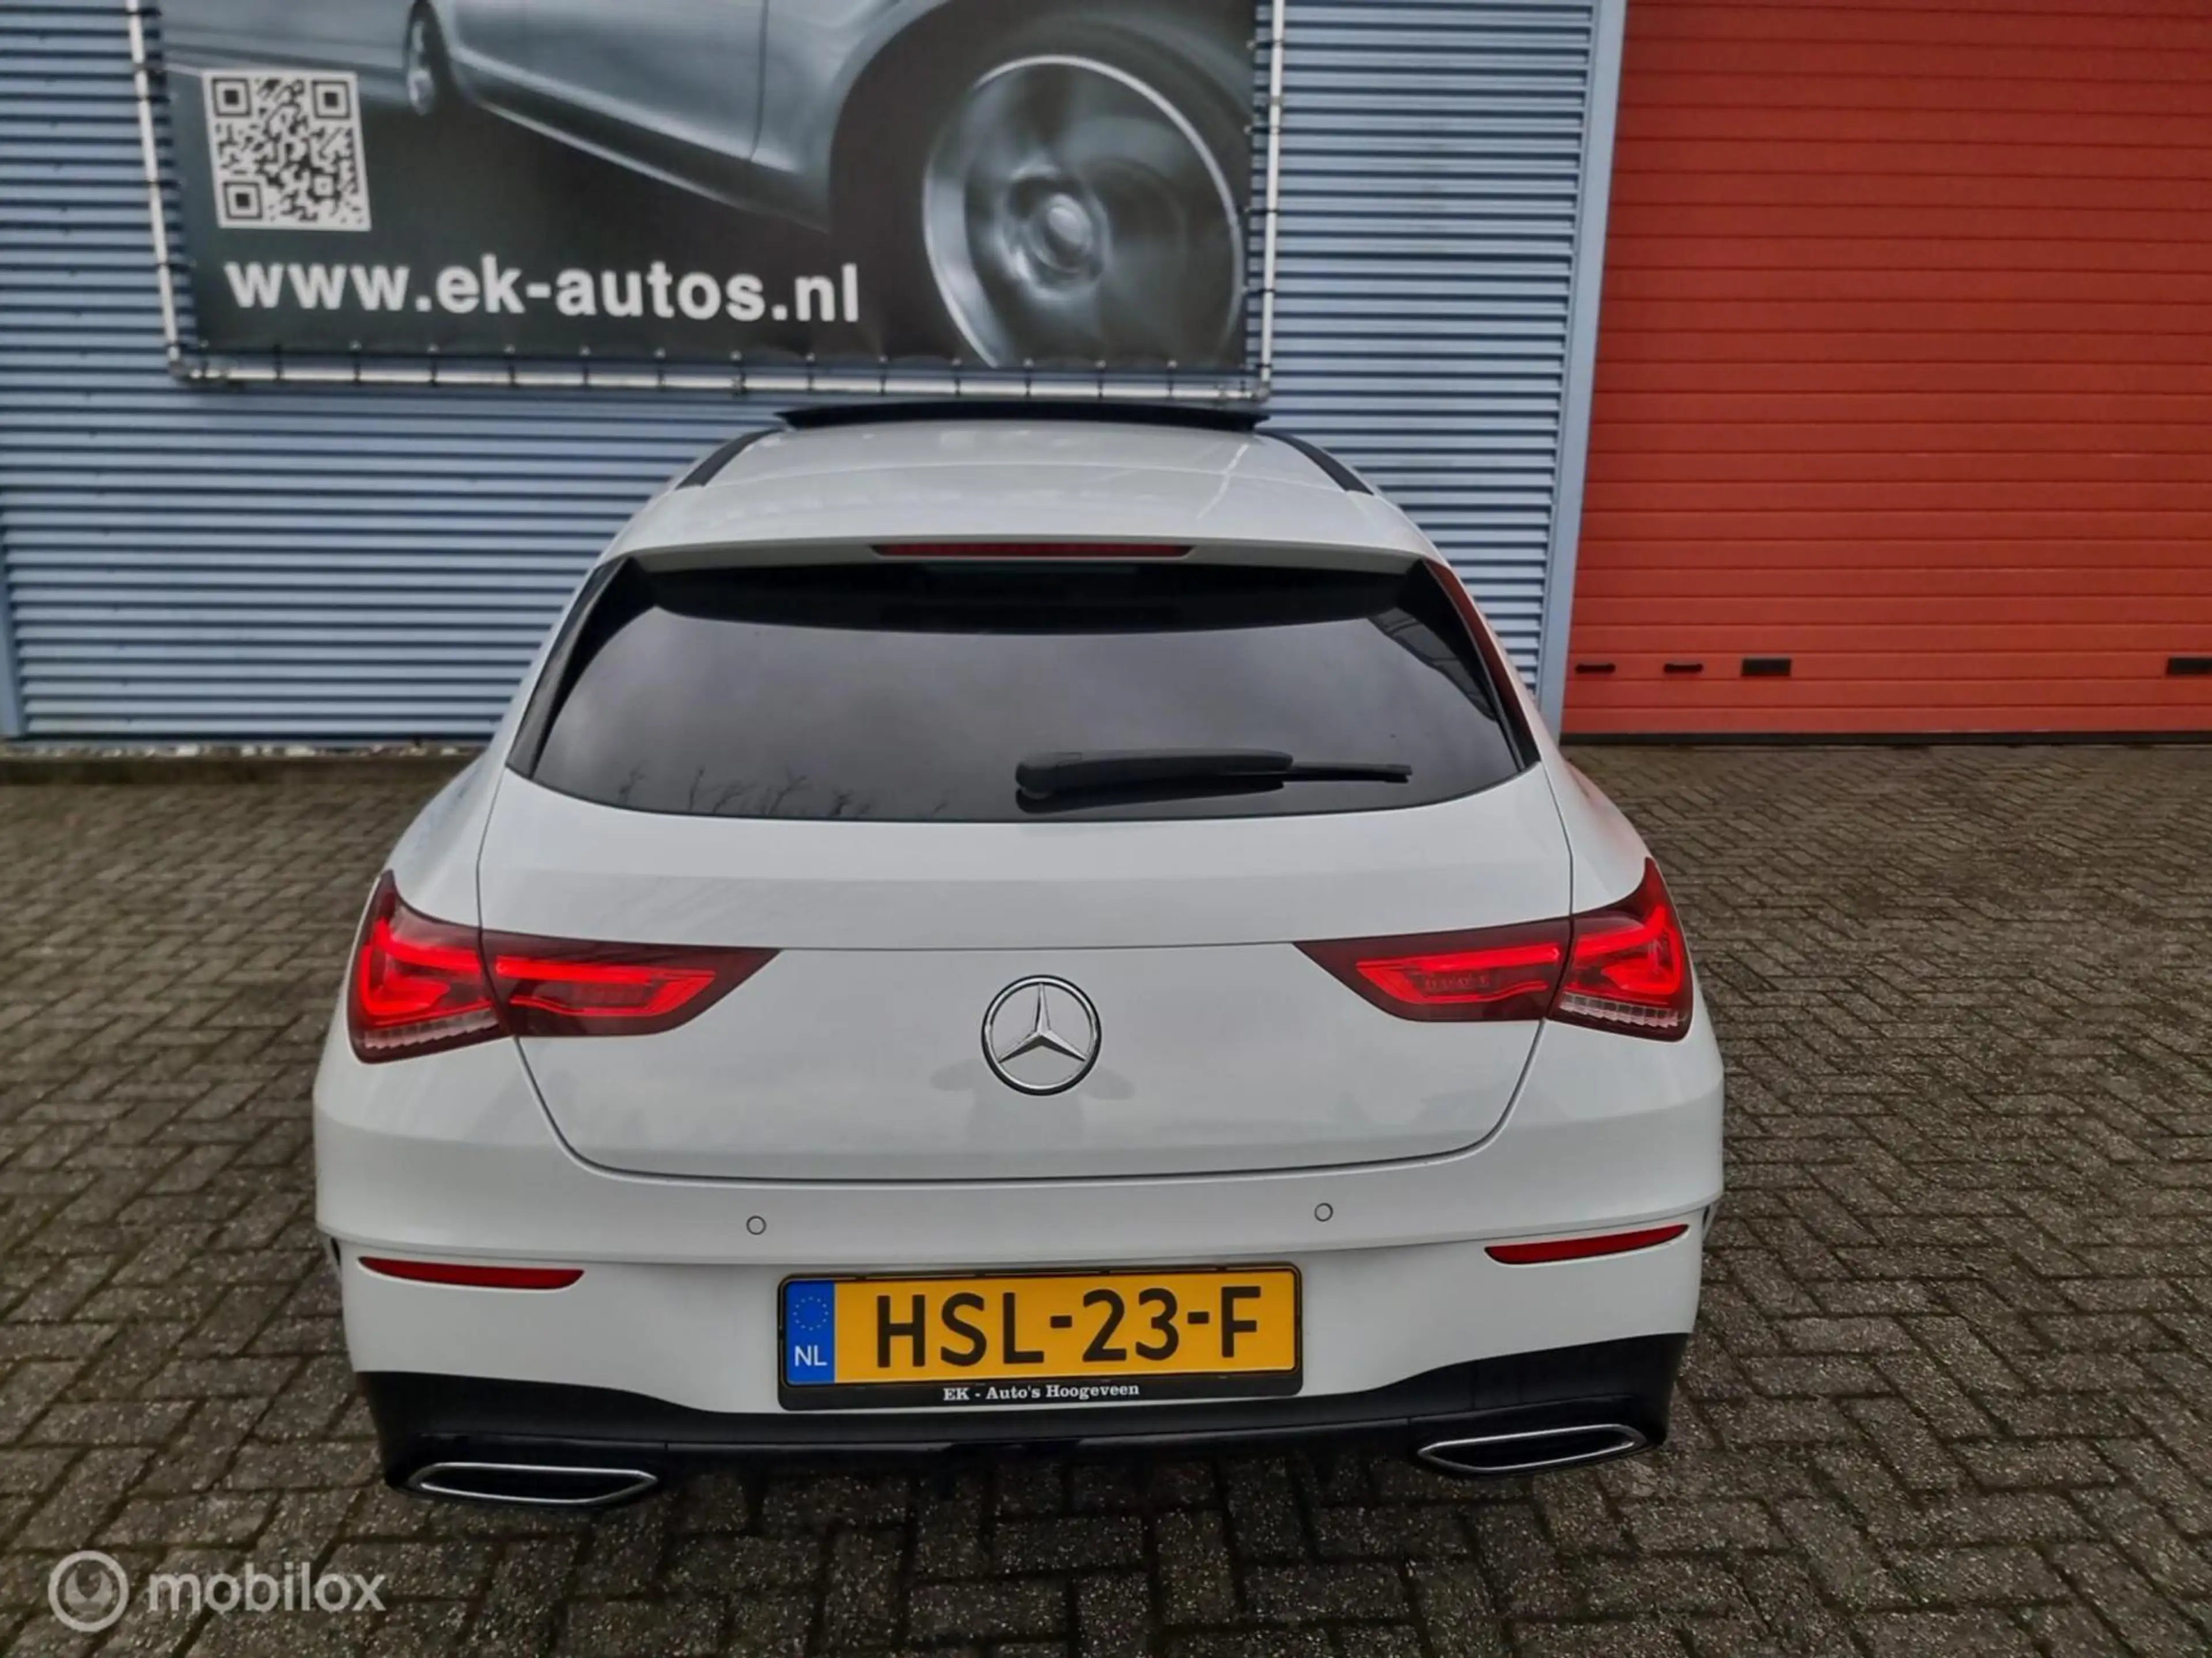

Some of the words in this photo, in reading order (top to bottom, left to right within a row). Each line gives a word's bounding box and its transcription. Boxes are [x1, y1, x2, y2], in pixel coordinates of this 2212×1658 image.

[224, 253, 859, 323] www.ek-autos.nl
[877, 1285, 1262, 1368] HSL-23-F
[794, 1345, 827, 1367] NL
[943, 1387, 970, 1401] EK
[986, 1384, 1041, 1400] Auto's
[1046, 1384, 1139, 1399] Hoogeveen
